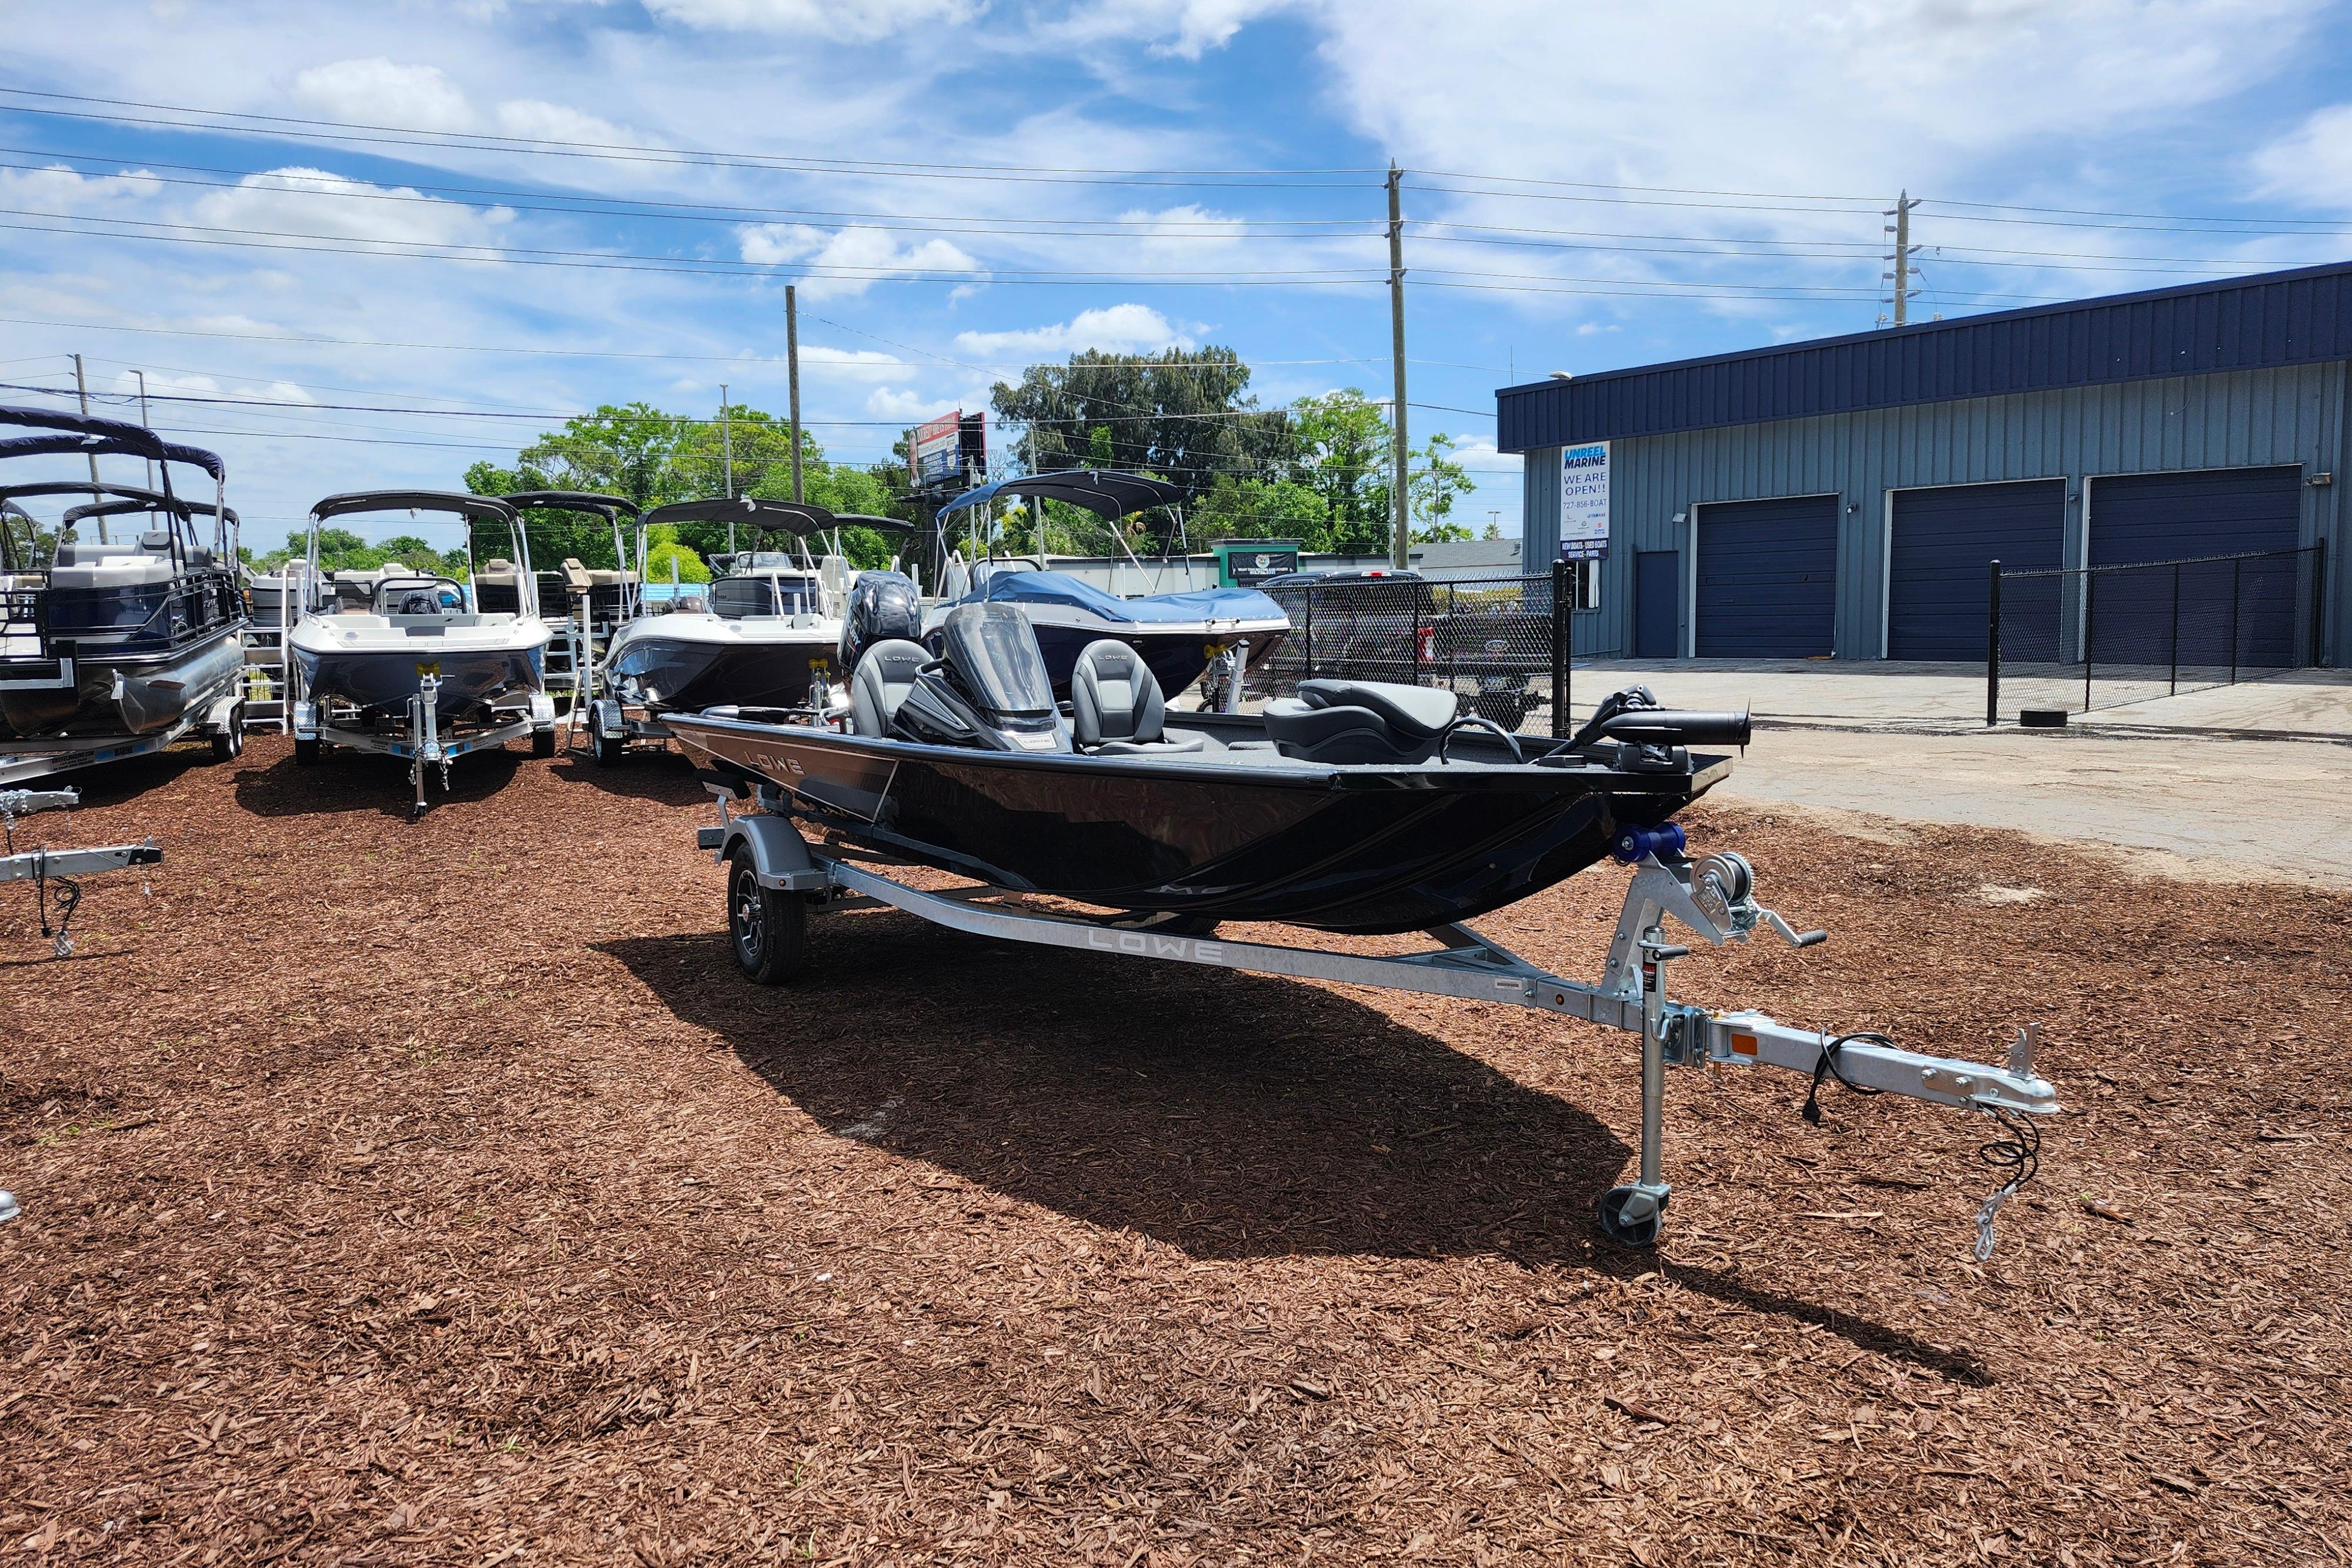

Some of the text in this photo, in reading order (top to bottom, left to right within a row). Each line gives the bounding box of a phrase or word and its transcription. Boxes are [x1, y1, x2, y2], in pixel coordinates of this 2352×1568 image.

[1565, 446, 1606, 460] UNREEL
[1564, 455, 1606, 469] MARINE
[1563, 472, 1606, 484] WE ARE
[1565, 483, 1605, 496] OPEN!!
[1563, 499, 1607, 509] 727-856-BOAT
[1562, 542, 1571, 550] NEW
[1584, 540, 1594, 549] USED
[1595, 540, 1607, 548] BOATS
[1568, 550, 1585, 559] SERVICE
[744, 751, 806, 775] LOWE
[1088, 930, 1222, 962] LOWE
